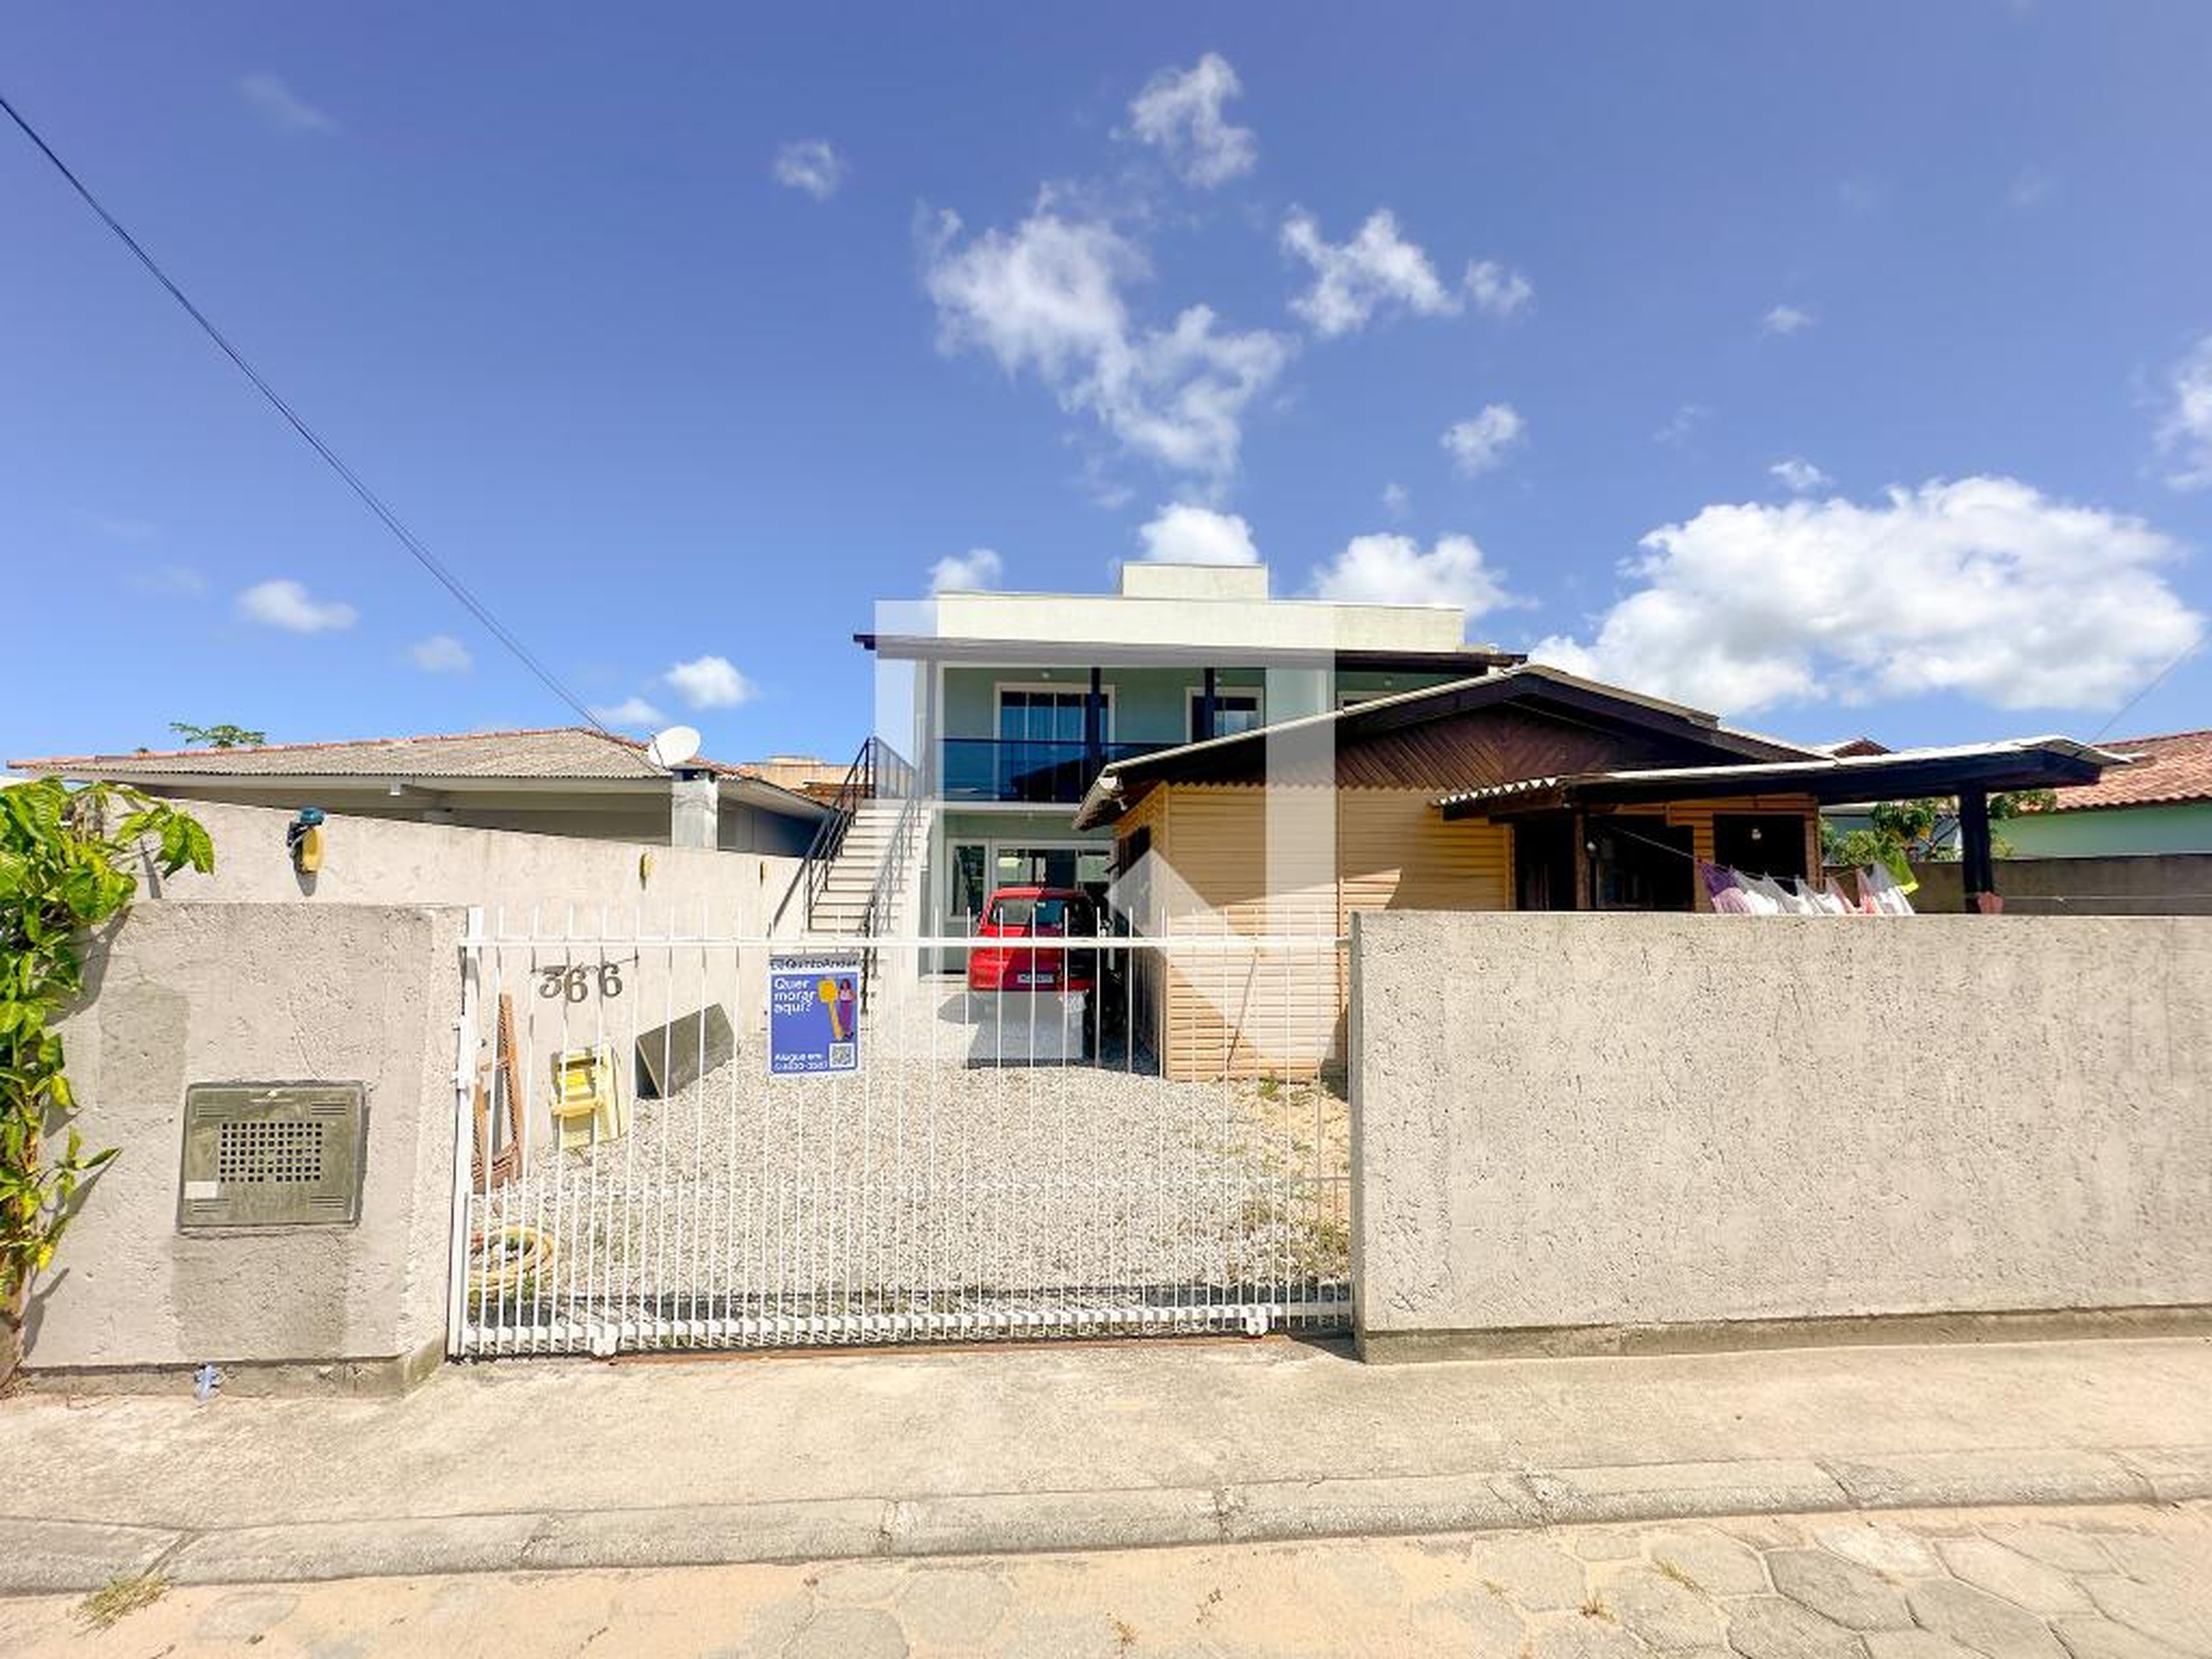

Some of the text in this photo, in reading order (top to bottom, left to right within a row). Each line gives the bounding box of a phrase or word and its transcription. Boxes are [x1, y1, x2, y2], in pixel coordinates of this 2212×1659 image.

[539, 964, 623, 1002] 366
[775, 978, 810, 990] Quer
[774, 991, 816, 1001] morar
